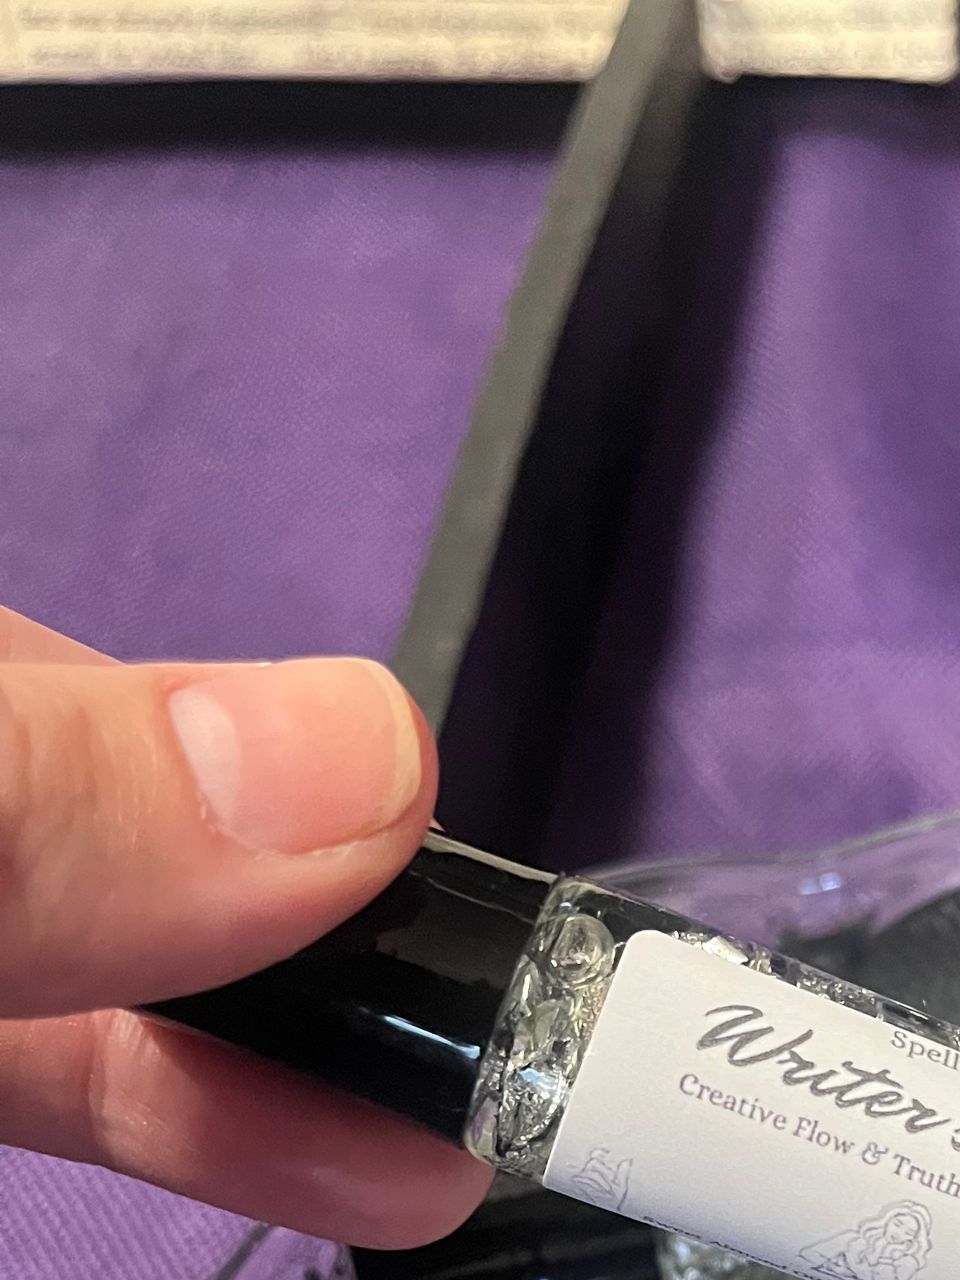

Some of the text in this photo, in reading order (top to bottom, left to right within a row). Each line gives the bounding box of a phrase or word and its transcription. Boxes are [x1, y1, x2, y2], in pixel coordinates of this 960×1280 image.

[890, 1030, 960, 1071] Spell
[679, 1073, 787, 1131] Creative
[792, 1116, 855, 1155] Flow
[861, 1141, 889, 1166] &
